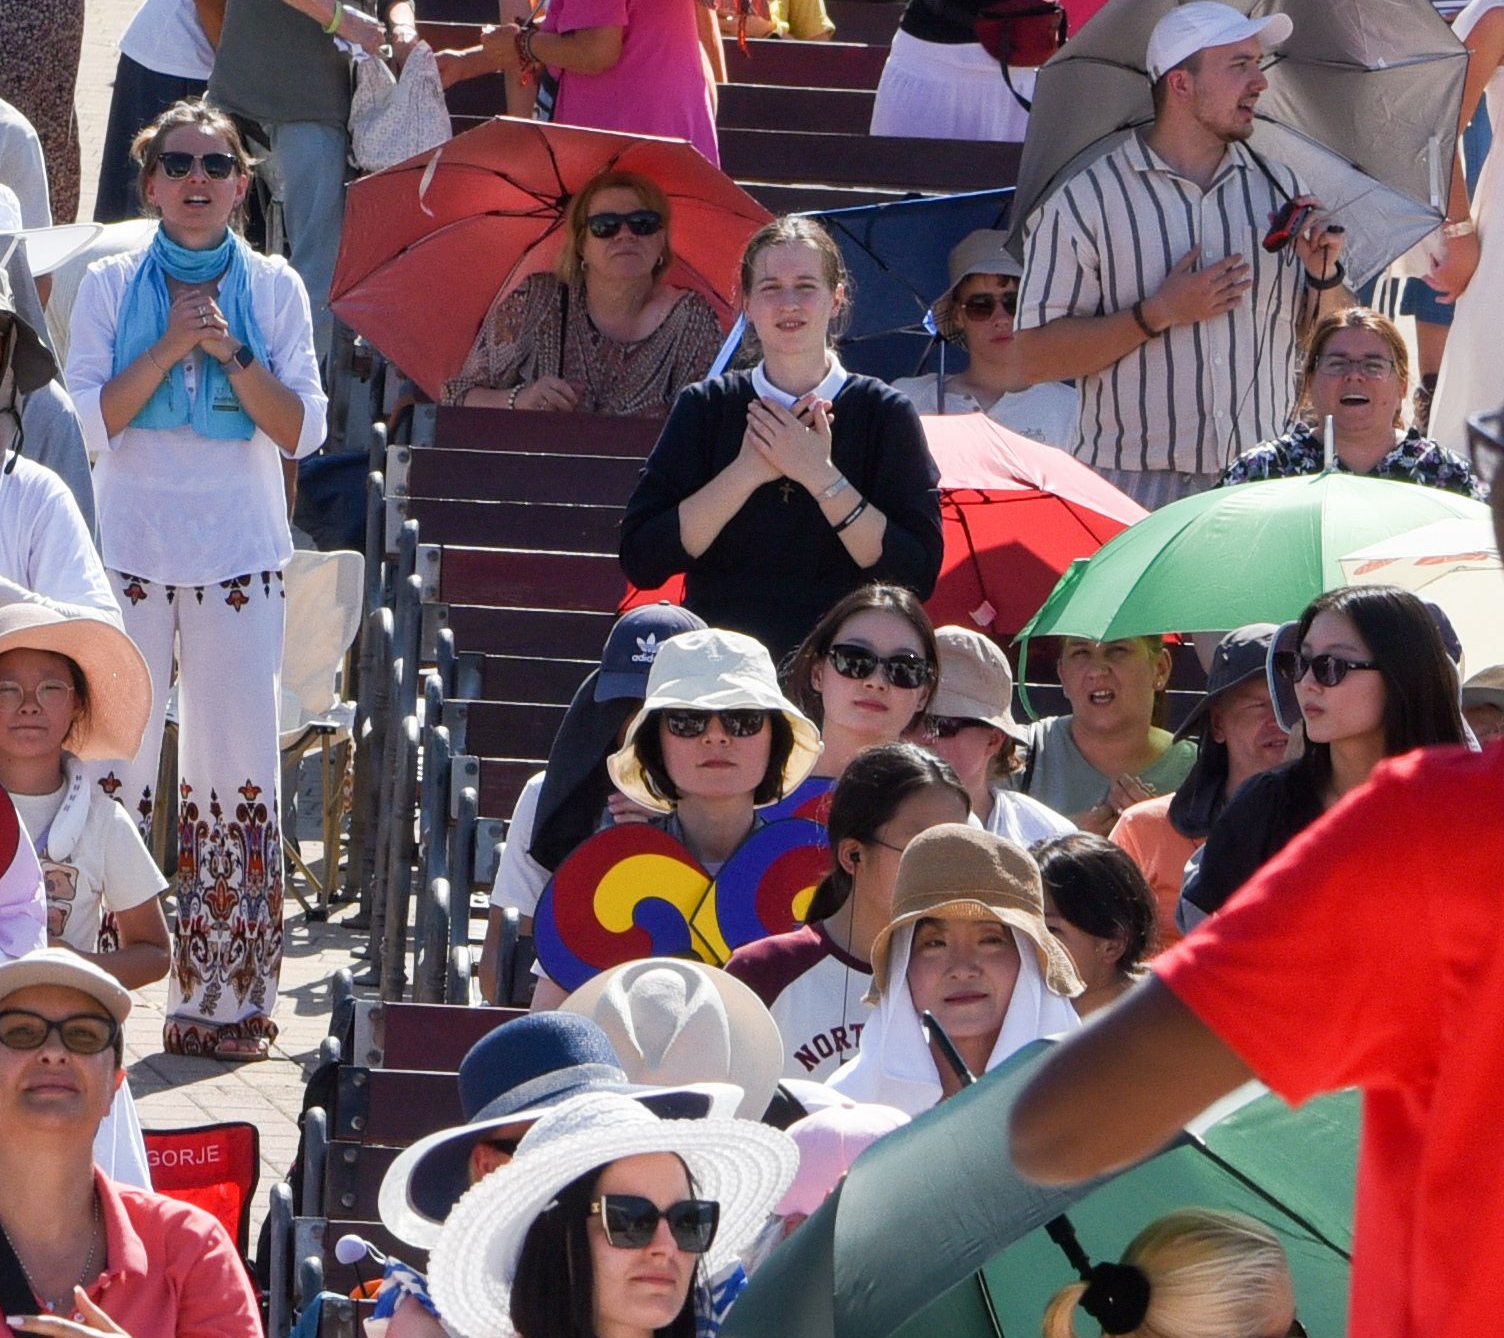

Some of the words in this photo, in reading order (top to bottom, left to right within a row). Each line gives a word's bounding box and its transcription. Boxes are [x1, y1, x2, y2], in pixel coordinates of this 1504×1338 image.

[632, 652, 655, 663] adid
[793, 1023, 866, 1072] NORT
[147, 1144, 220, 1167] GORJE
